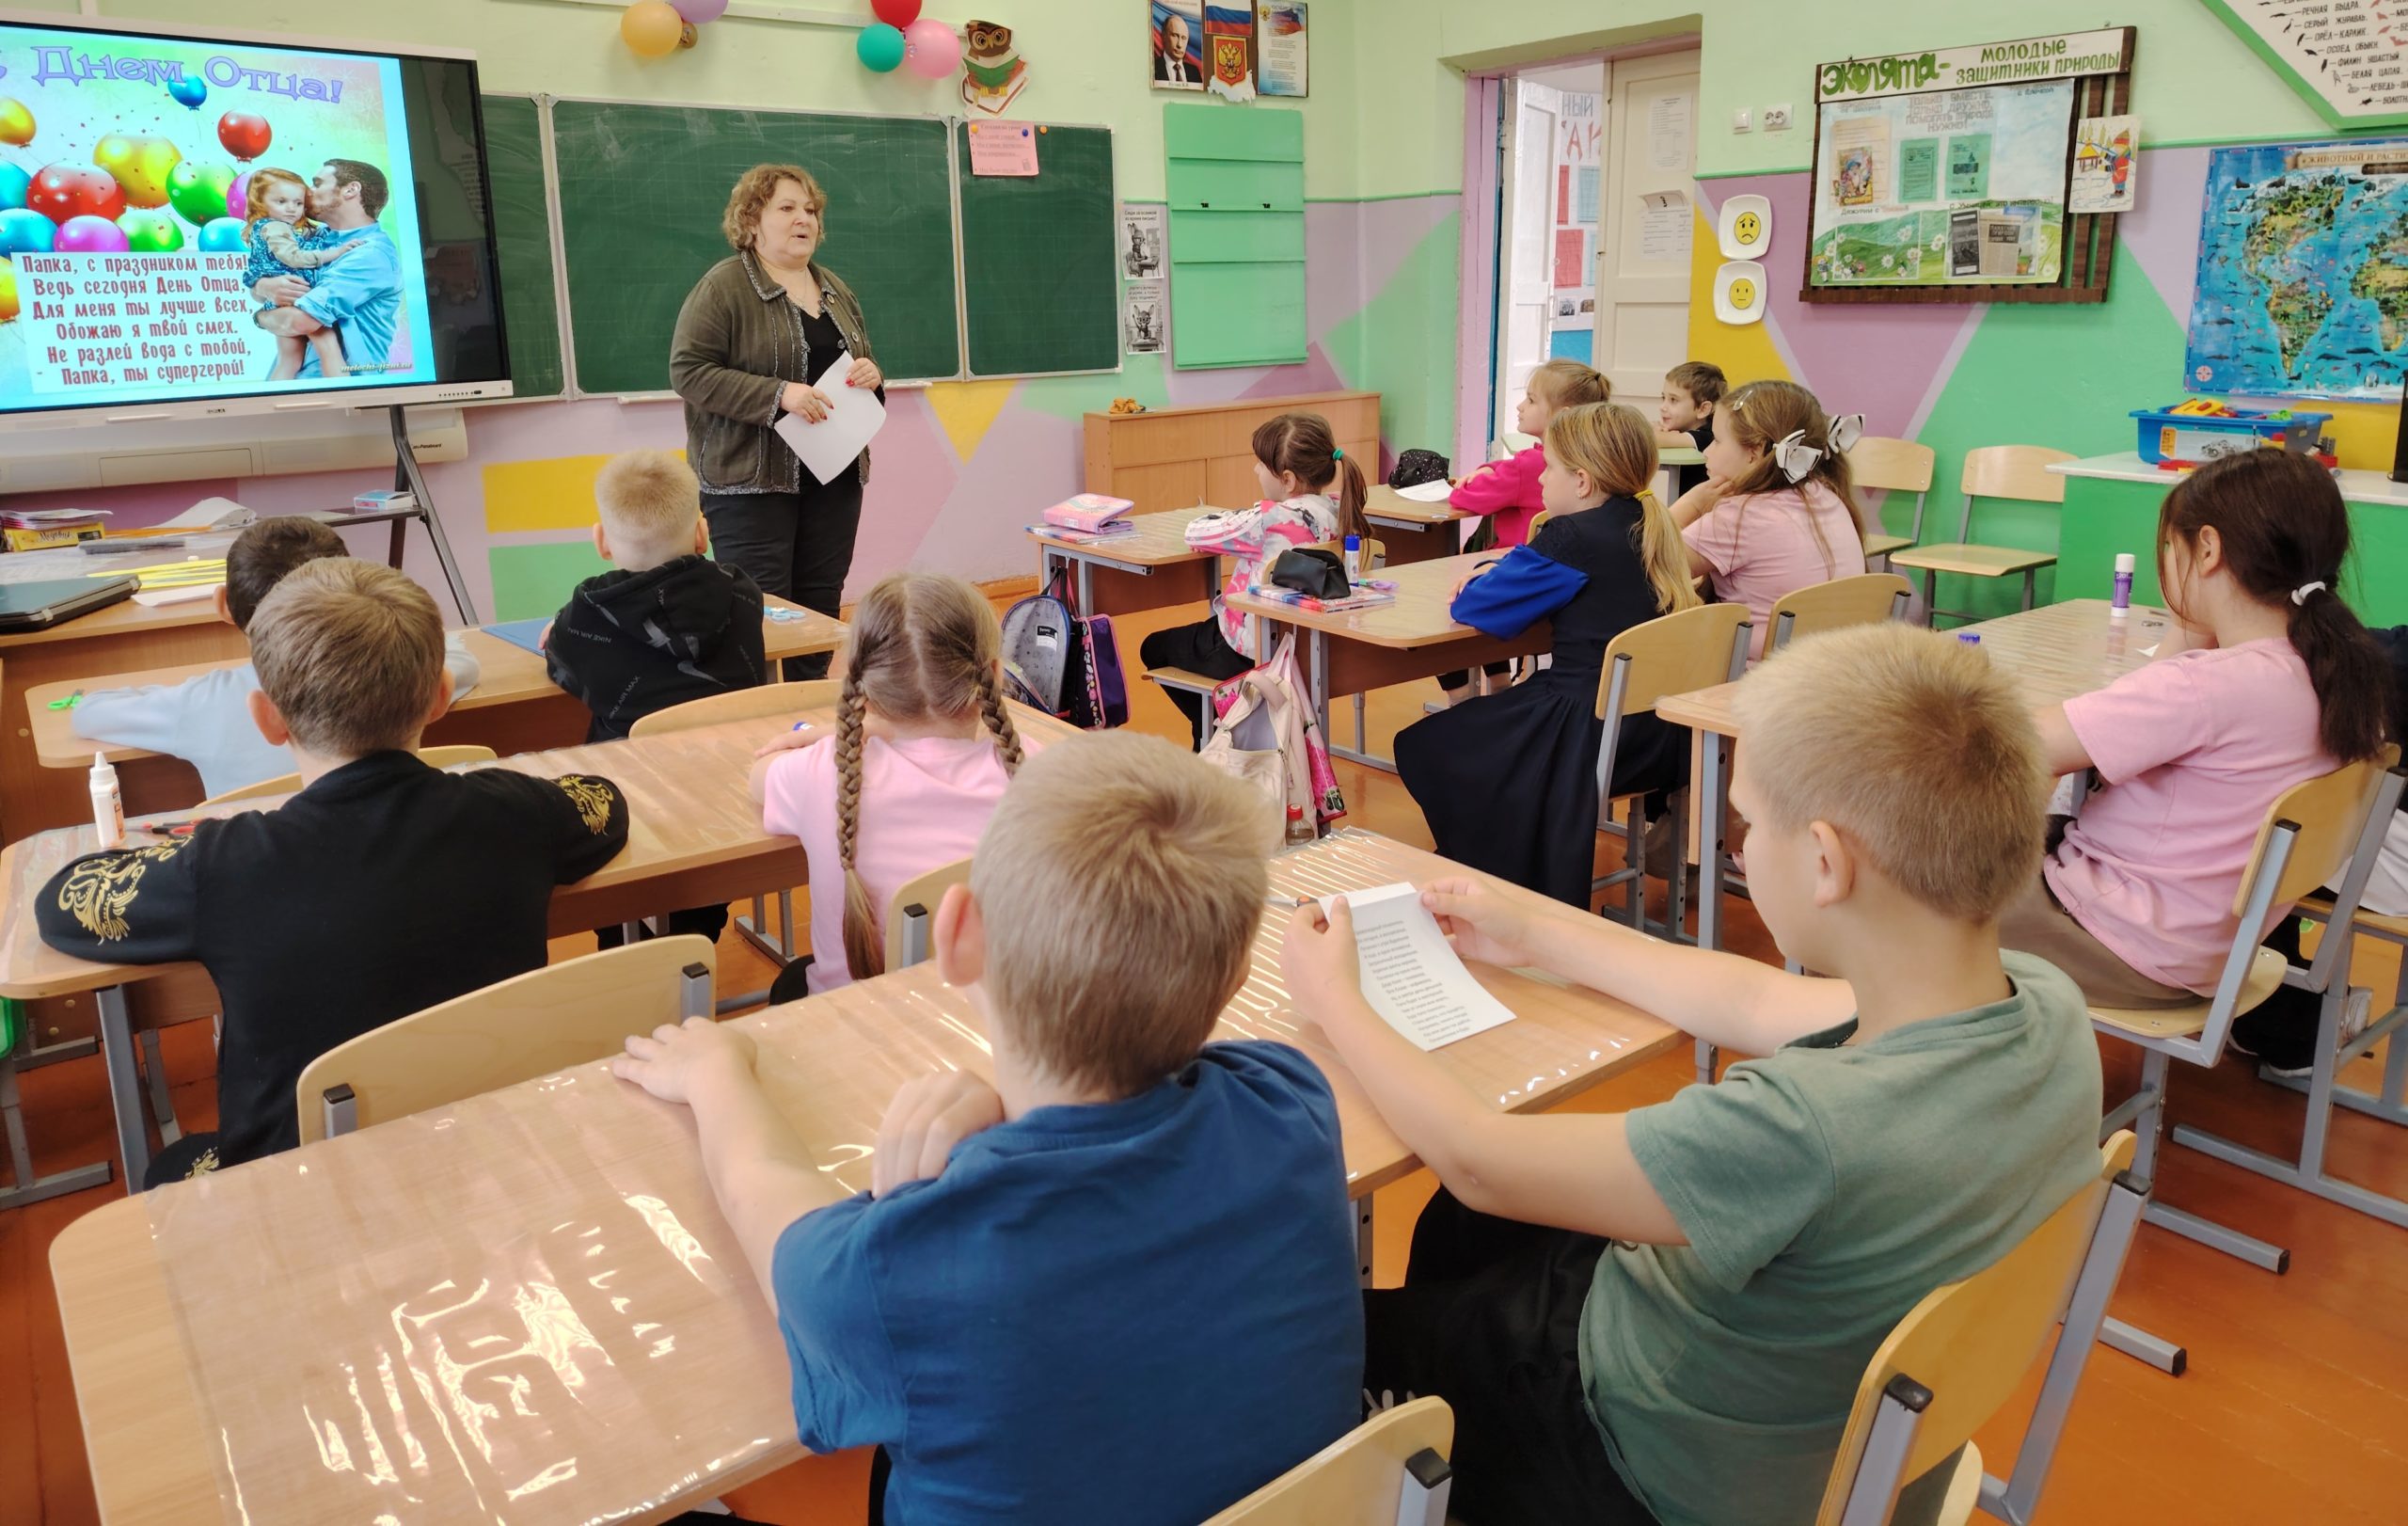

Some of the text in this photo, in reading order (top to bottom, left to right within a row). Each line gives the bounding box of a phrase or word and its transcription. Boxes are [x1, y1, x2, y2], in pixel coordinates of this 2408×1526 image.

[2302, 5, 2328, 15] РЕЧНАЯ
[2304, 17, 2328, 29] СЕРЫЙ
[2326, 45, 2351, 54] ОСОЕД
[2337, 56, 2362, 67] ФИЛИН
[204, 56, 343, 103] Отца!
[2351, 70, 2372, 79] БЕЛАЯ
[2308, 153, 2364, 164] ЖИВОТНЫЙ
[23, 254, 247, 277] Папка, с праздником тебя!
[33, 276, 246, 300] Ведь сегодня День Отца,
[33, 296, 254, 320] Для меня ты лучше всех,
[56, 319, 238, 341] Обожаю я твой смех.
[47, 338, 251, 367] Не разлей вода с тобой,
[61, 358, 245, 385] Папка, ты супергерой!
